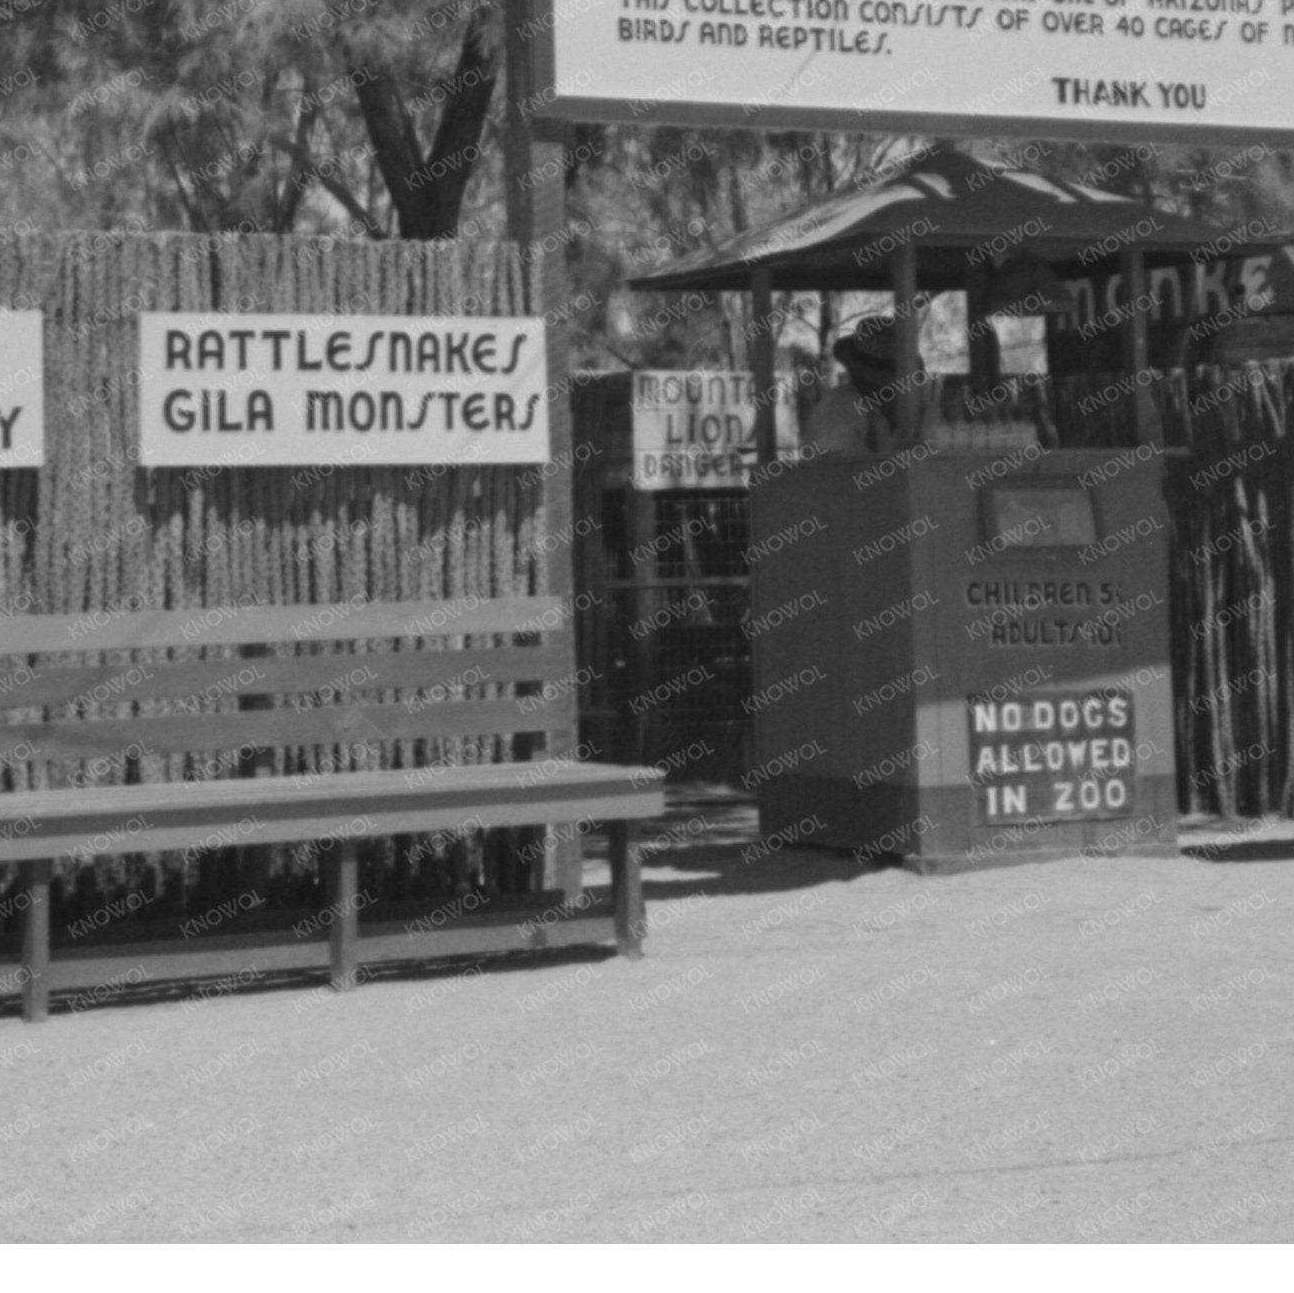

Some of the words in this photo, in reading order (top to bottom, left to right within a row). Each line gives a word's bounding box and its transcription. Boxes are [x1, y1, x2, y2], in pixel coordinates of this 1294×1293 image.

[617, 16, 691, 44] BIRDS
[698, 20, 749, 48] AND
[757, 23, 892, 56] REPTILES.
[857, 0, 984, 30] CONSISTS
[995, 7, 1030, 32] OF
[1041, 10, 1105, 36] OVER
[1115, 15, 1146, 39] 40
[1153, 16, 1229, 42] CAGES
[1238, 20, 1270, 45] OF
[1050, 76, 1151, 108] THANK
[1156, 81, 1207, 111] YOU
[164, 328, 528, 376] RATTLESNAKES
[162, 388, 275, 434] GILA
[305, 389, 541, 434] MONSTERS
[966, 581, 1091, 606] CHILDREN
[975, 703, 1022, 733] NO
[1034, 697, 1128, 730] DOGS
[976, 738, 1131, 774] ALLOWED
[987, 783, 1027, 816] IN
[1054, 778, 1126, 811] ZOO
